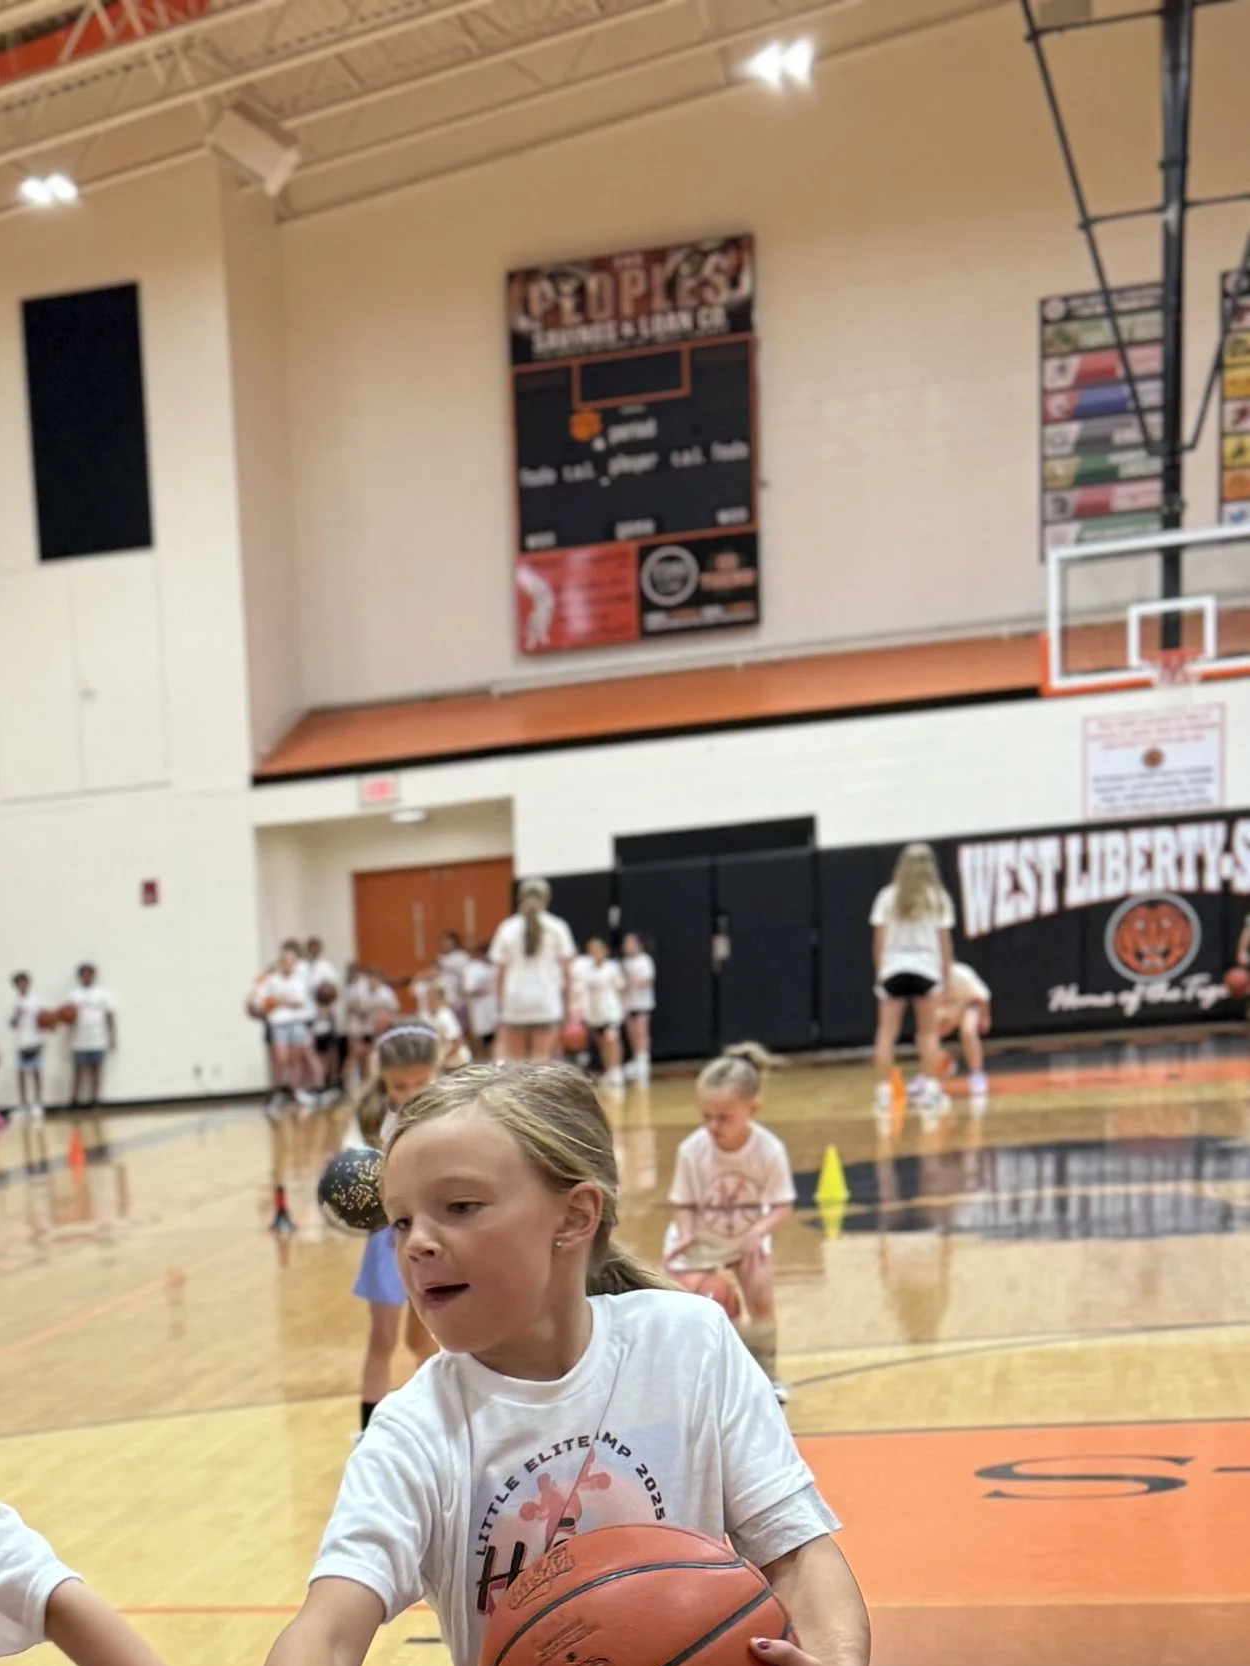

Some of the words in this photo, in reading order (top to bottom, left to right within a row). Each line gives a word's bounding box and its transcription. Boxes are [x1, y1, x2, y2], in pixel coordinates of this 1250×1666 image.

[526, 254, 731, 328] PEOPLES
[958, 835, 1062, 940] WEST
[1047, 982, 1115, 1013] Home
[1117, 982, 1146, 1018] of
[476, 1476, 520, 1557] LITTLE
[523, 1435, 591, 1474] ELITE
[635, 1463, 667, 1521] 2025
